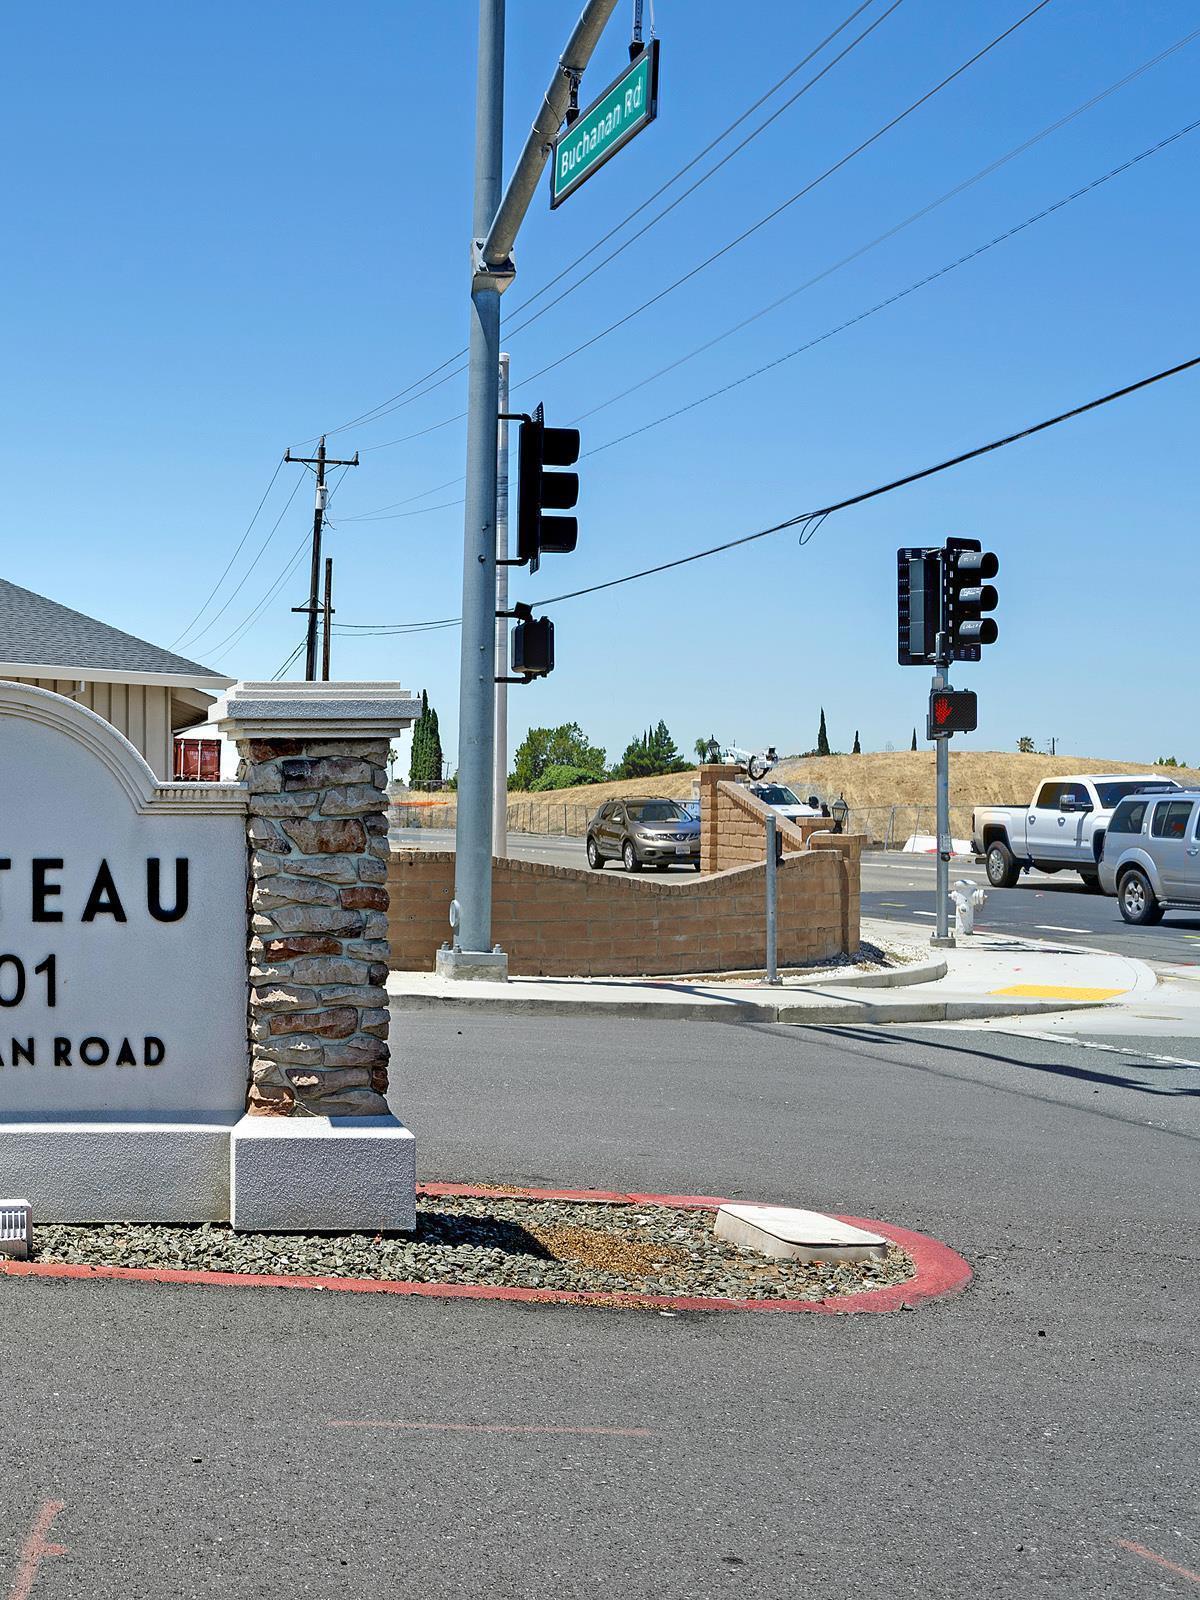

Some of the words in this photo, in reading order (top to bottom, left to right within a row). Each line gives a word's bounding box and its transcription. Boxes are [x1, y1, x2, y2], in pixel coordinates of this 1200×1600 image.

[560, 103, 621, 178] Buchanan
[624, 76, 643, 117] Rd
[54, 1037, 166, 1067] ROAD
